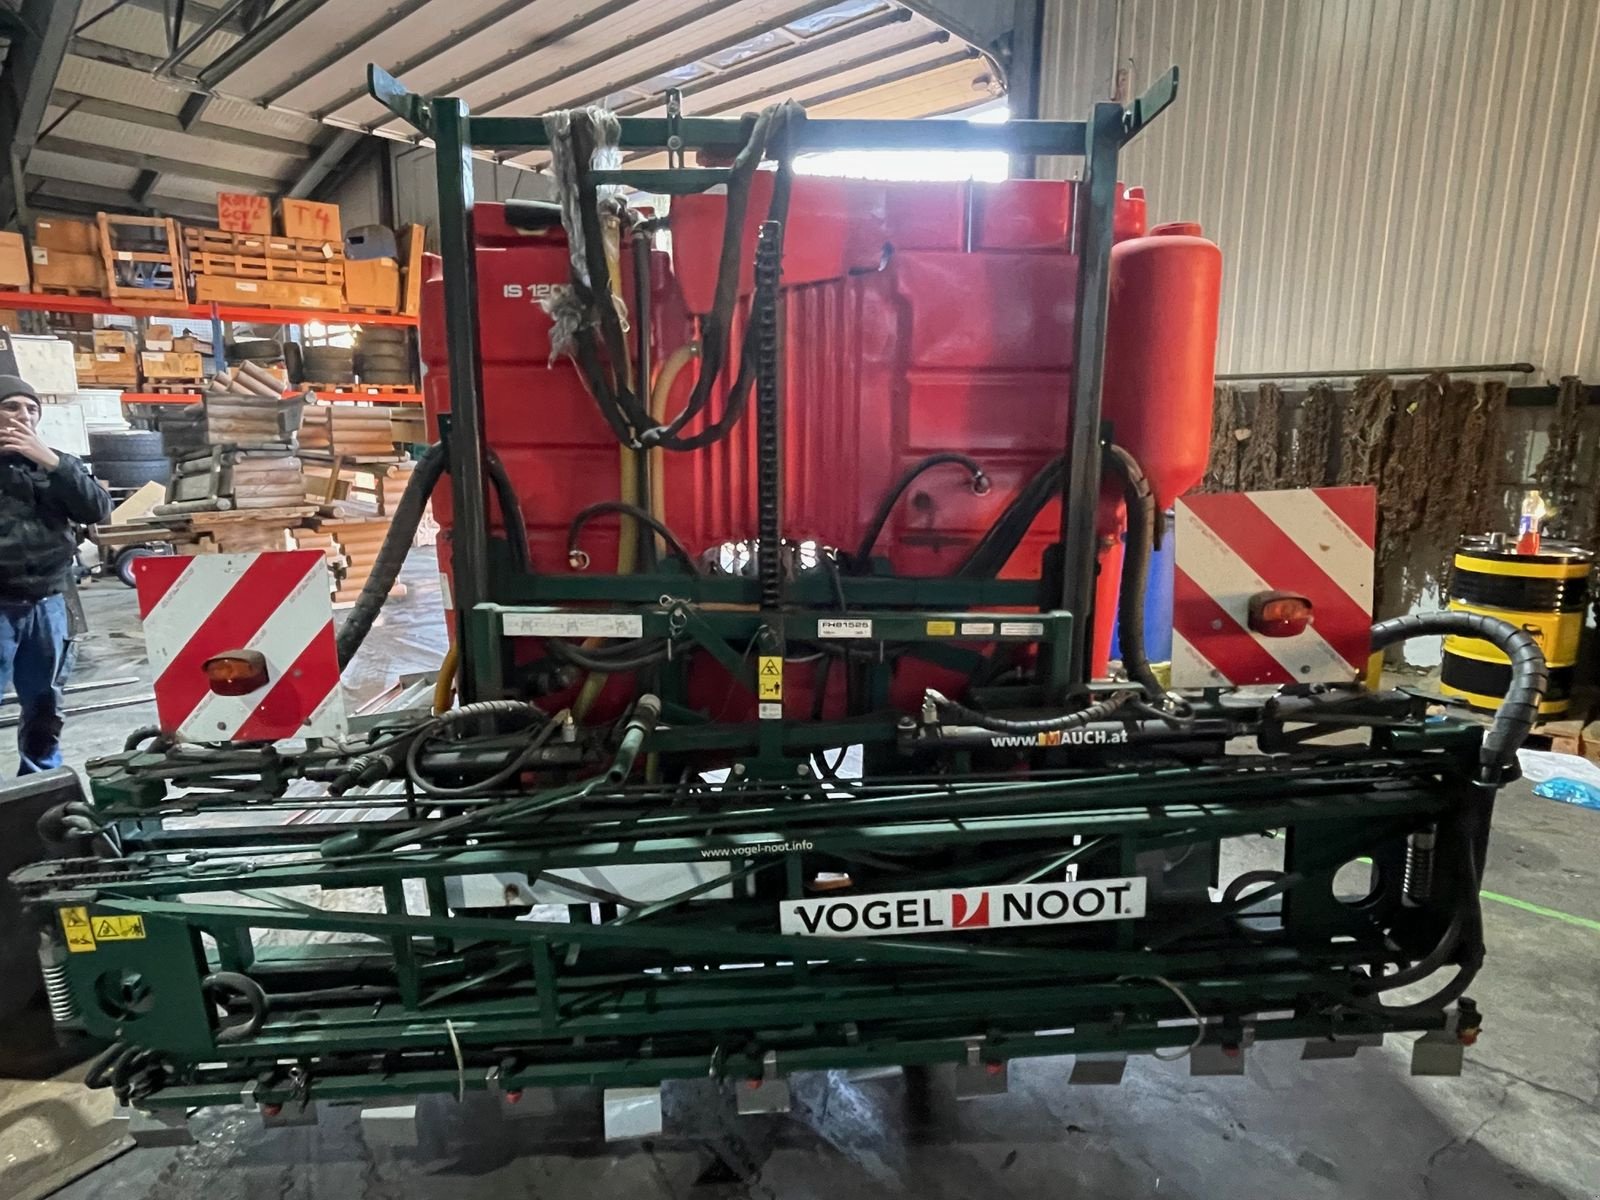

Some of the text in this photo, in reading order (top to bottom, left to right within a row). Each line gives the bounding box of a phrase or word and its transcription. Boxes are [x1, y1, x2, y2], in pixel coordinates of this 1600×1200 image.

[503, 284, 523, 298] IS
[701, 839, 813, 858] www.vogel-noot.info
[797, 898, 944, 934] VOGEL
